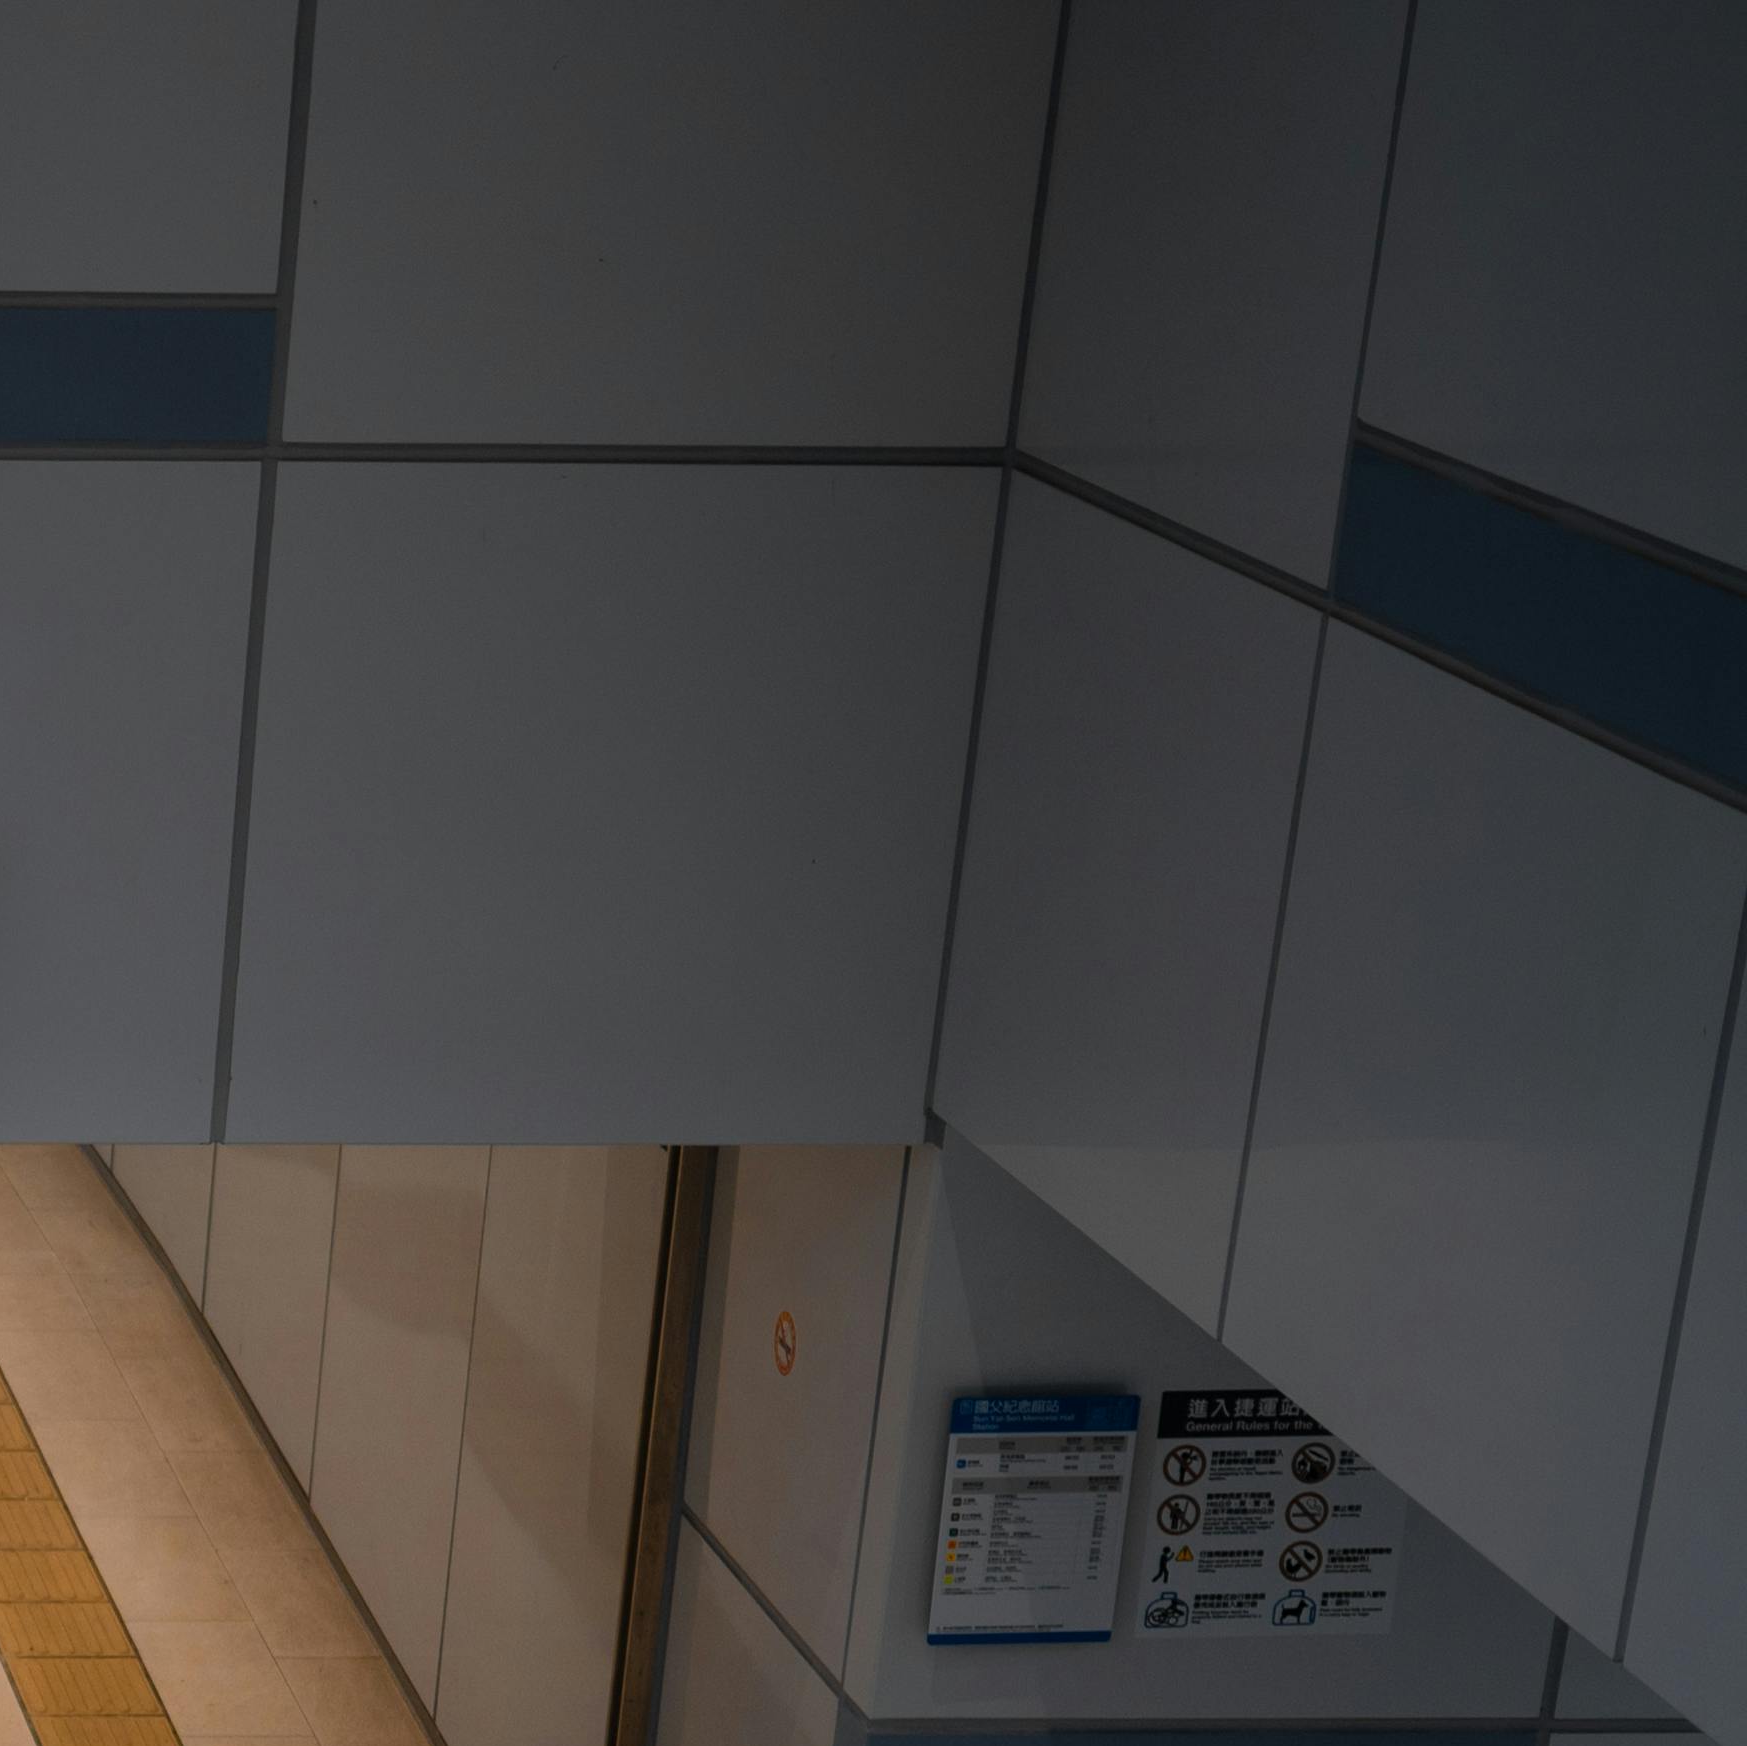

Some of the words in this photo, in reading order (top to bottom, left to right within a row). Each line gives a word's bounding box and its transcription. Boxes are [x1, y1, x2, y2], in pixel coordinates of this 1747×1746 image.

[1188, 1397, 1309, 1418] 進入捷運站
[1186, 1422, 1232, 1432] General
[1236, 1421, 1270, 1431] Rules
[1274, 1420, 1290, 1430] for
[1294, 1420, 1312, 1430] the
